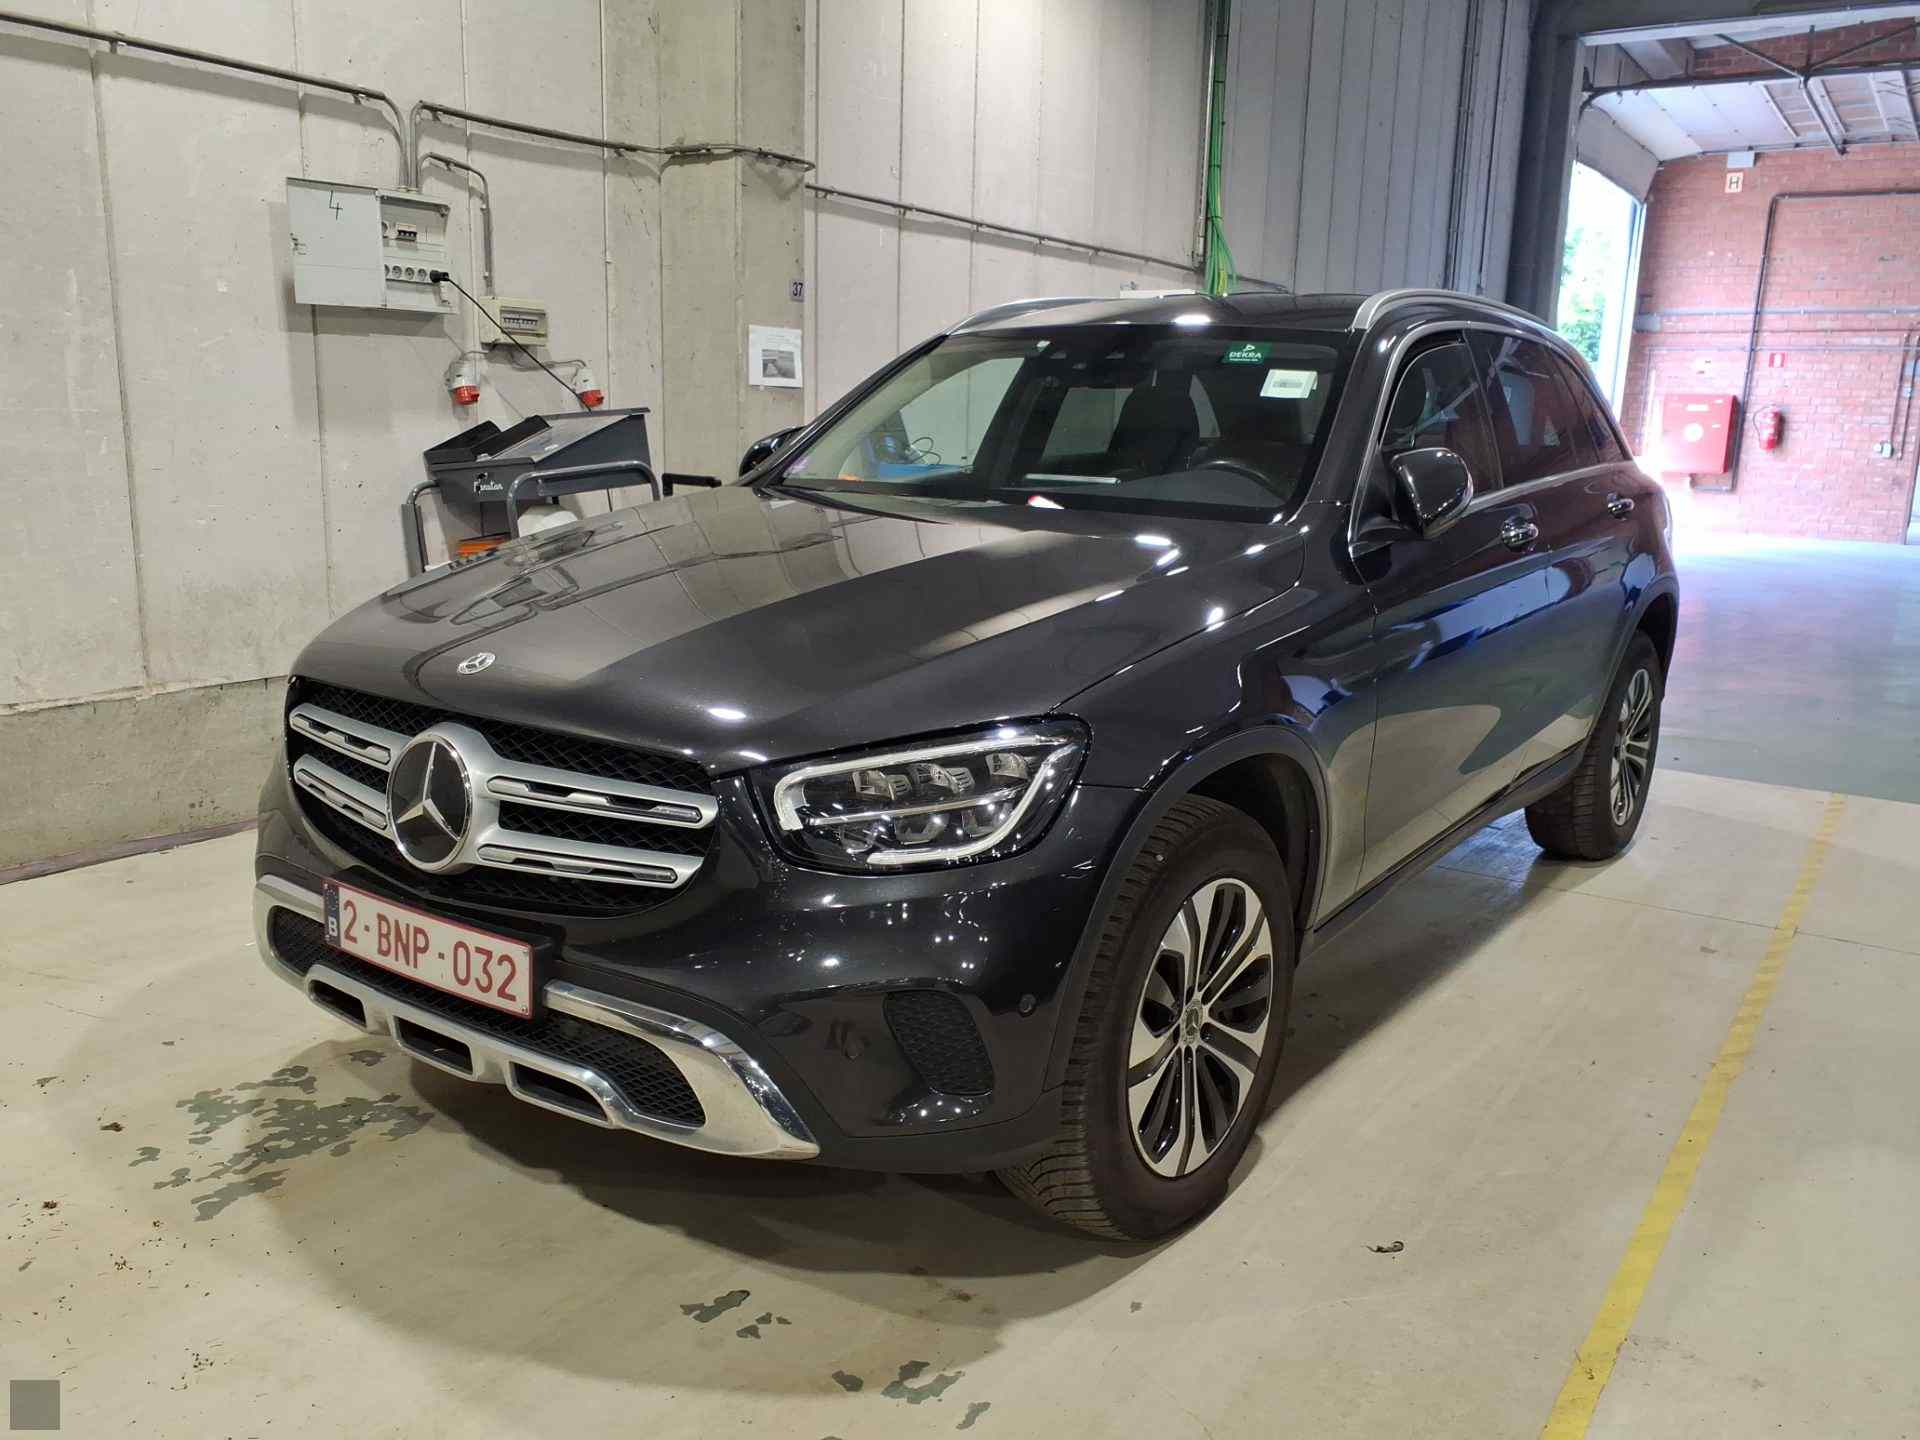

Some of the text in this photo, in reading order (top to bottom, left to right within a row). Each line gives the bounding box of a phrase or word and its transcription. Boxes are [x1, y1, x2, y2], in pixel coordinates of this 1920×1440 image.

[1728, 176, 1740, 190] H
[329, 189, 343, 221] 4
[792, 282, 803, 297] 37
[1229, 351, 1262, 359] DEKRA
[328, 916, 338, 937] B
[343, 900, 517, 1002] 2-BNP-032
